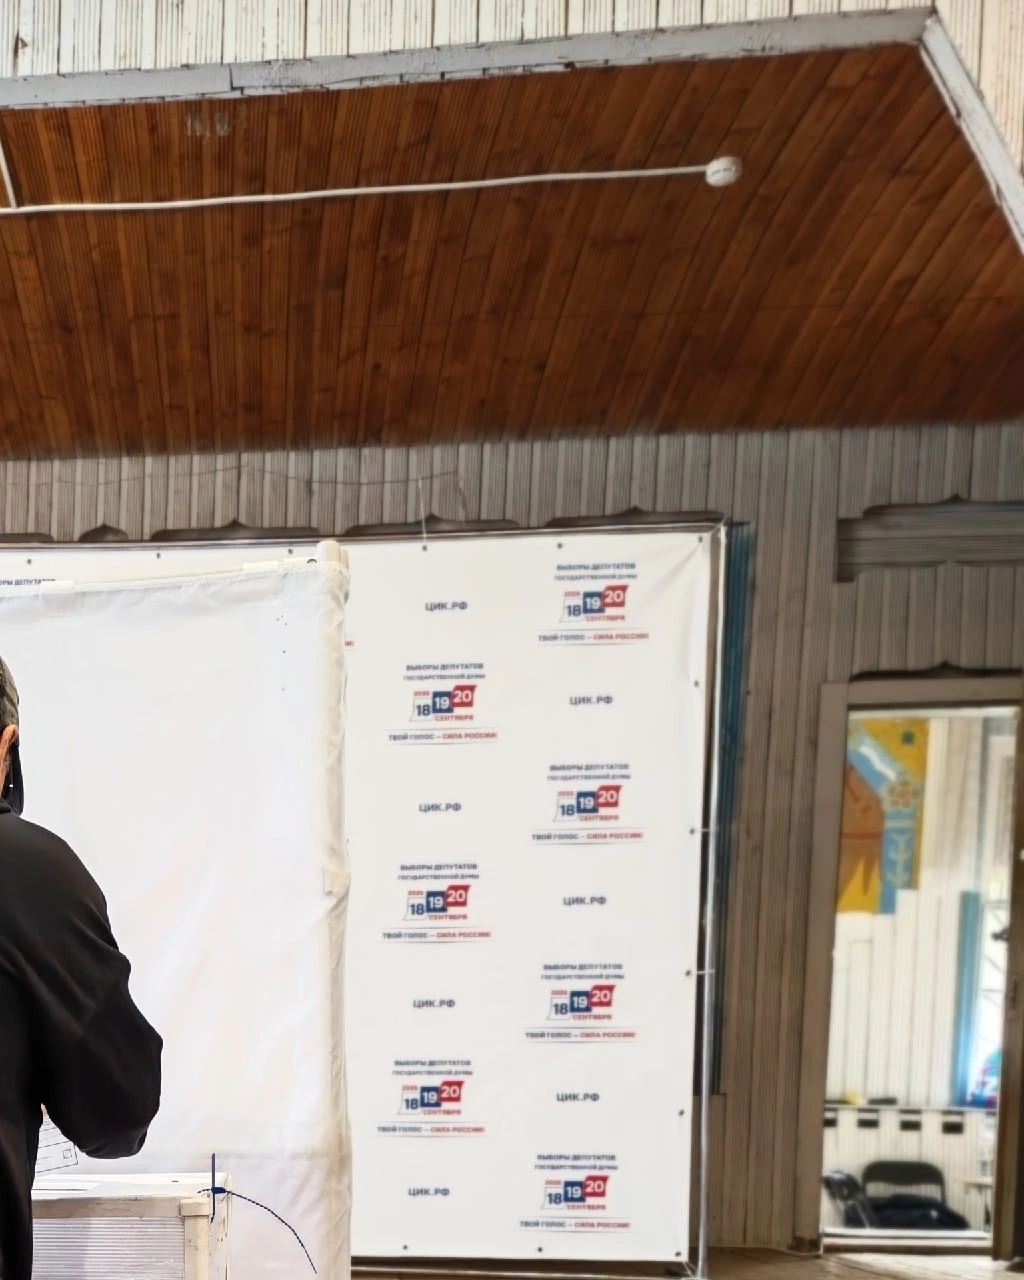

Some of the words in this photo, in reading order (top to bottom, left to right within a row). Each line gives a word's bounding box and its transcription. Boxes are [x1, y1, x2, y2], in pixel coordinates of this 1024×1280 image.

[556, 563, 590, 571] ВЫБОРЫ
[14, 578, 56, 586] ДЕПУТА
[425, 601, 468, 612] ЦИК.РФ
[566, 604, 582, 617] 18
[584, 597, 601, 610] 19
[605, 590, 624, 603] 20
[416, 704, 431, 717] 18
[434, 696, 450, 710] 19
[453, 690, 472, 703] 20
[570, 695, 613, 706] ЦИК.РФ
[419, 803, 461, 813] ЦИК.РФ
[560, 804, 575, 816] 18
[578, 796, 595, 810] 19
[598, 790, 617, 803] 20
[410, 903, 425, 916] 18
[428, 896, 444, 909] 19
[447, 890, 466, 902] 20
[563, 896, 607, 906] ЦИК.РФ
[413, 999, 455, 1009] ЦИК.РФ
[553, 1003, 568, 1015] 18
[572, 996, 588, 1009] 19
[591, 990, 610, 1003] 20
[394, 1059, 427, 1067] ВЫБОРЫ
[404, 1098, 419, 1110] 18
[422, 1091, 439, 1104] 19
[441, 1085, 460, 1098] 20
[557, 1093, 600, 1103] ЦИК.РФ
[408, 1188, 450, 1197] ЦИК.РФ
[547, 1193, 562, 1205] 18
[566, 1186, 582, 1198] 19
[585, 1180, 604, 1193] 20
